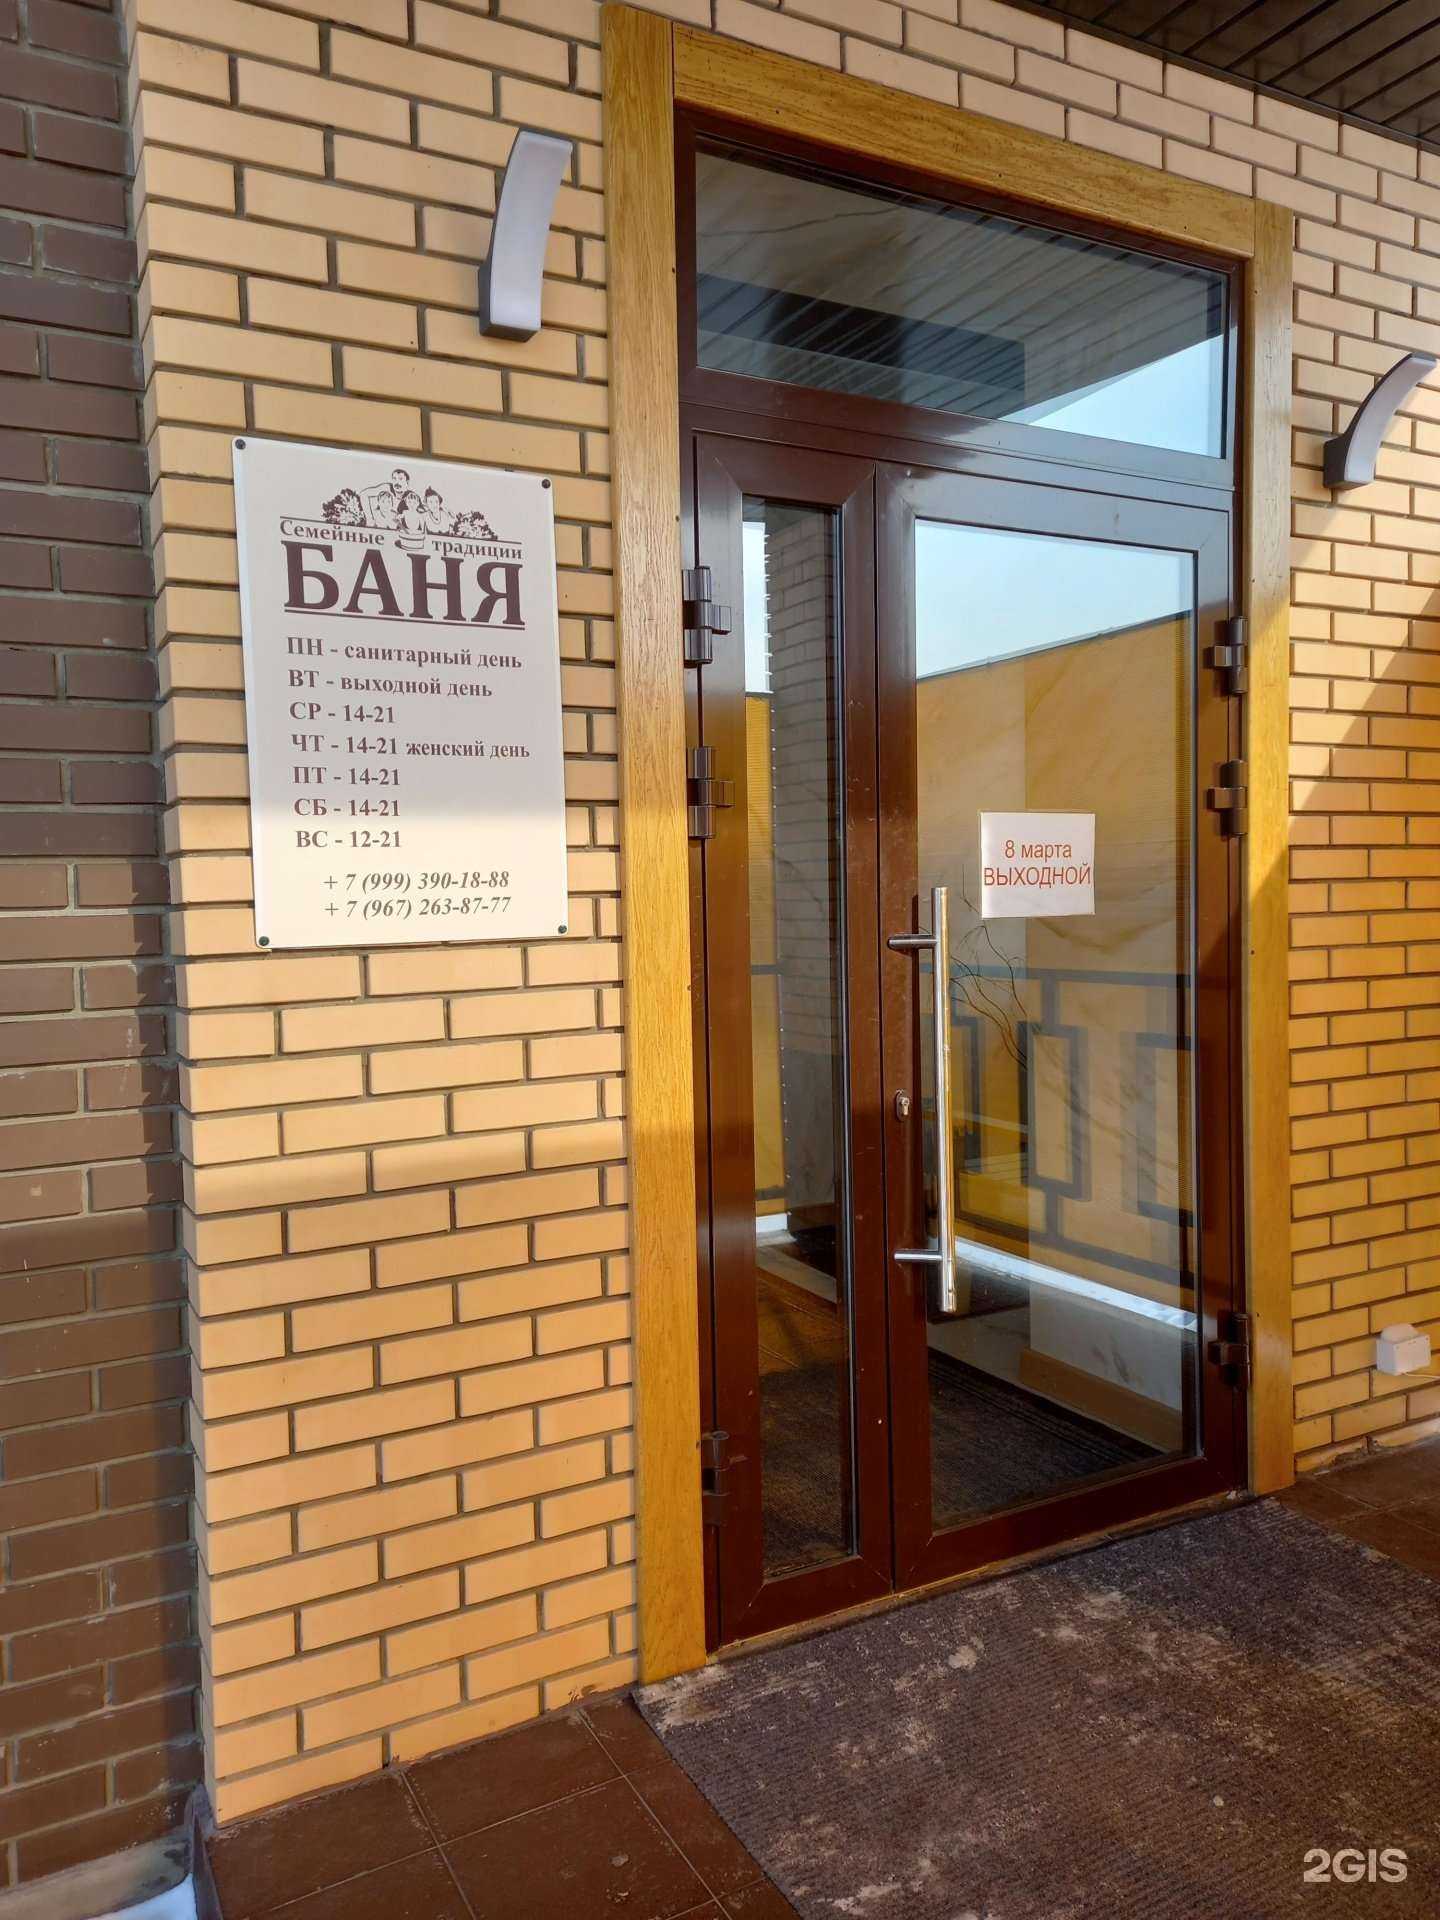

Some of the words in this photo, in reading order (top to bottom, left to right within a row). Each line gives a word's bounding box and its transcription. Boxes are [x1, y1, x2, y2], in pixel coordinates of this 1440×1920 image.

[280, 519, 385, 546] Семейные
[431, 539, 523, 560] традиции
[281, 540, 526, 626] БАНЯ
[287, 637, 324, 656] ПН
[344, 644, 471, 668] санитарный
[477, 653, 522, 670] день
[288, 669, 320, 688] ВТ
[341, 675, 441, 695] выходной
[447, 682, 493, 698] день
[289, 702, 322, 720] СР
[343, 705, 396, 724] 14-21
[291, 734, 325, 753] ЧТ
[347, 736, 398, 755] 14-21
[406, 740, 484, 758] женский
[489, 745, 530, 761] день
[293, 766, 327, 784] ПТ
[348, 768, 400, 786] 14-21
[294, 798, 328, 816] СБ
[348, 799, 400, 817] 14-21
[296, 830, 328, 848] ВС
[351, 831, 401, 848] 12-21
[1005, 840, 1015, 859] 8
[1021, 844, 1072, 863] марта
[345, 873, 356, 891] 7
[361, 873, 411, 894] (999)
[418, 871, 510, 890] 390-18-88
[984, 862, 1091, 889] ВЫХОДНОЙ
[346, 900, 357, 918] 7
[362, 899, 412, 920] (967)
[419, 896, 511, 916] 263-87-77
